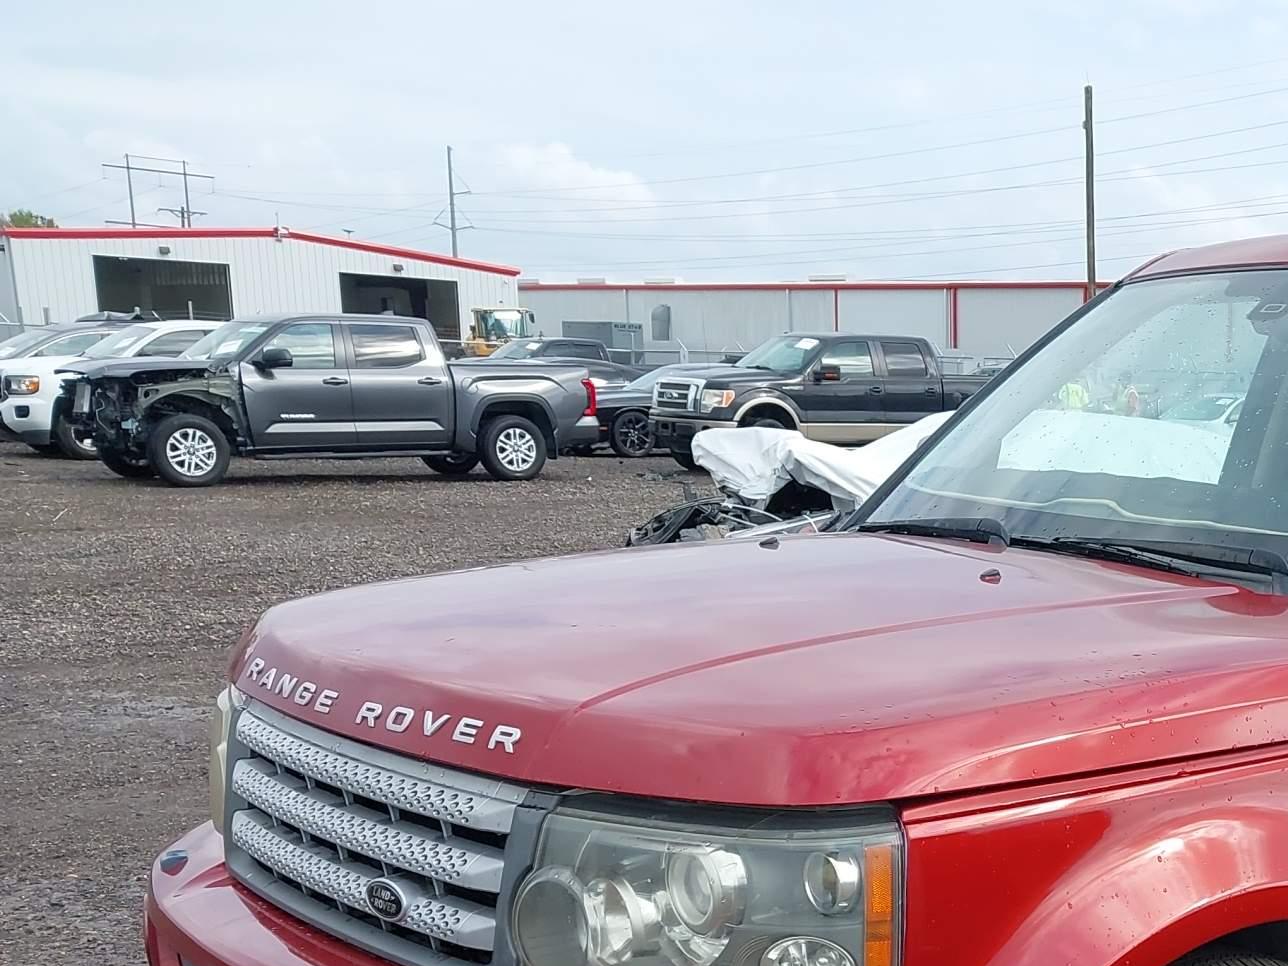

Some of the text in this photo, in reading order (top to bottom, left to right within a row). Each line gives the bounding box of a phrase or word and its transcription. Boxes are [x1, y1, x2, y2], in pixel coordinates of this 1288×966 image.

[246, 656, 522, 755] RANGE ROVER
[372, 886, 397, 914] LAND ROVER
